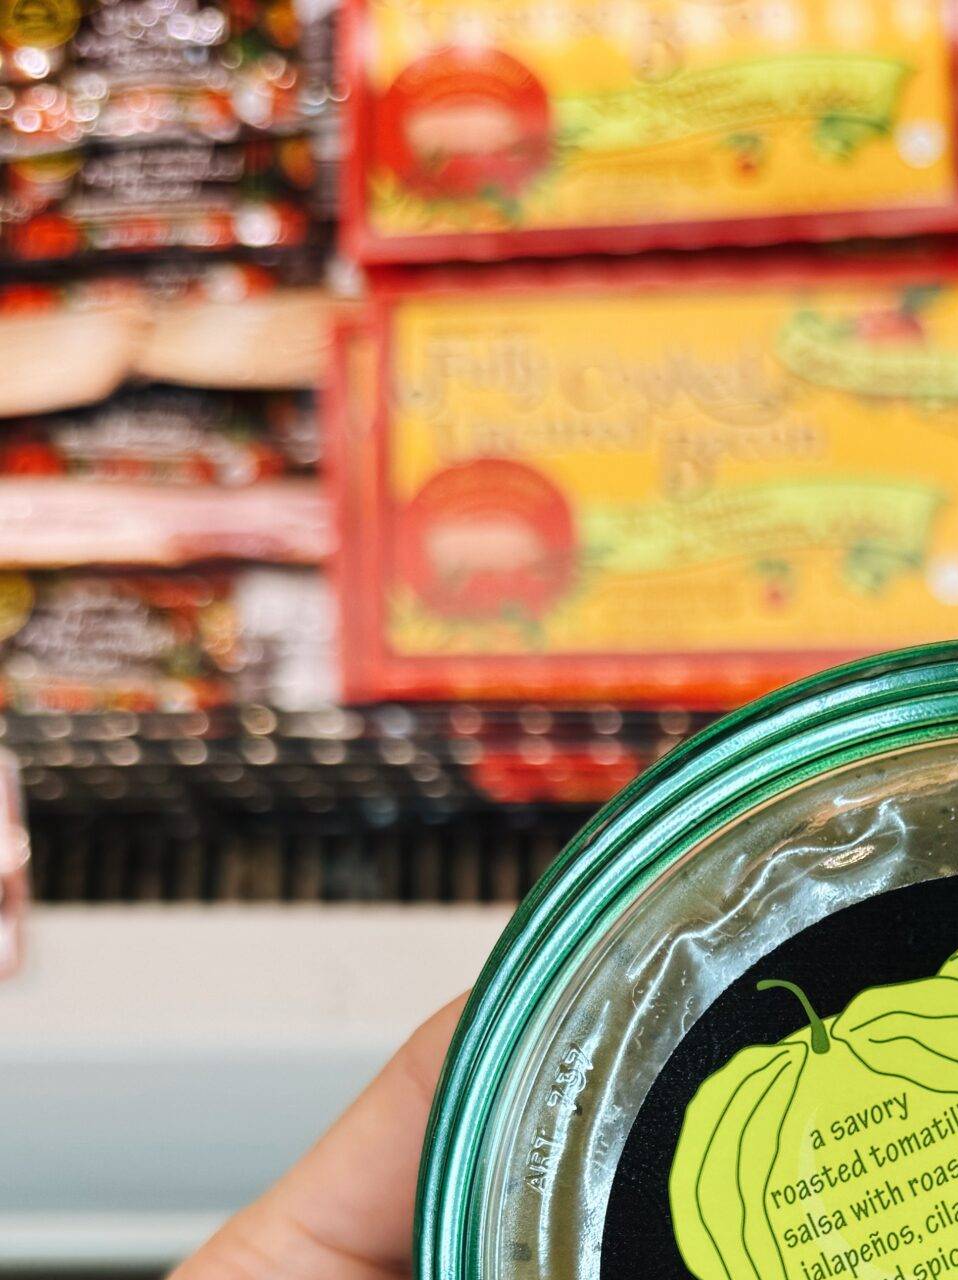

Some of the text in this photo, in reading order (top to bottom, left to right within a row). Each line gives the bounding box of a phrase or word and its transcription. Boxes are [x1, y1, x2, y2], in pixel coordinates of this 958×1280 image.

[809, 1092, 909, 1150] a savory
[770, 1149, 867, 1209] roasted
[783, 1209, 847, 1248] salsa
[850, 1181, 905, 1222] with
